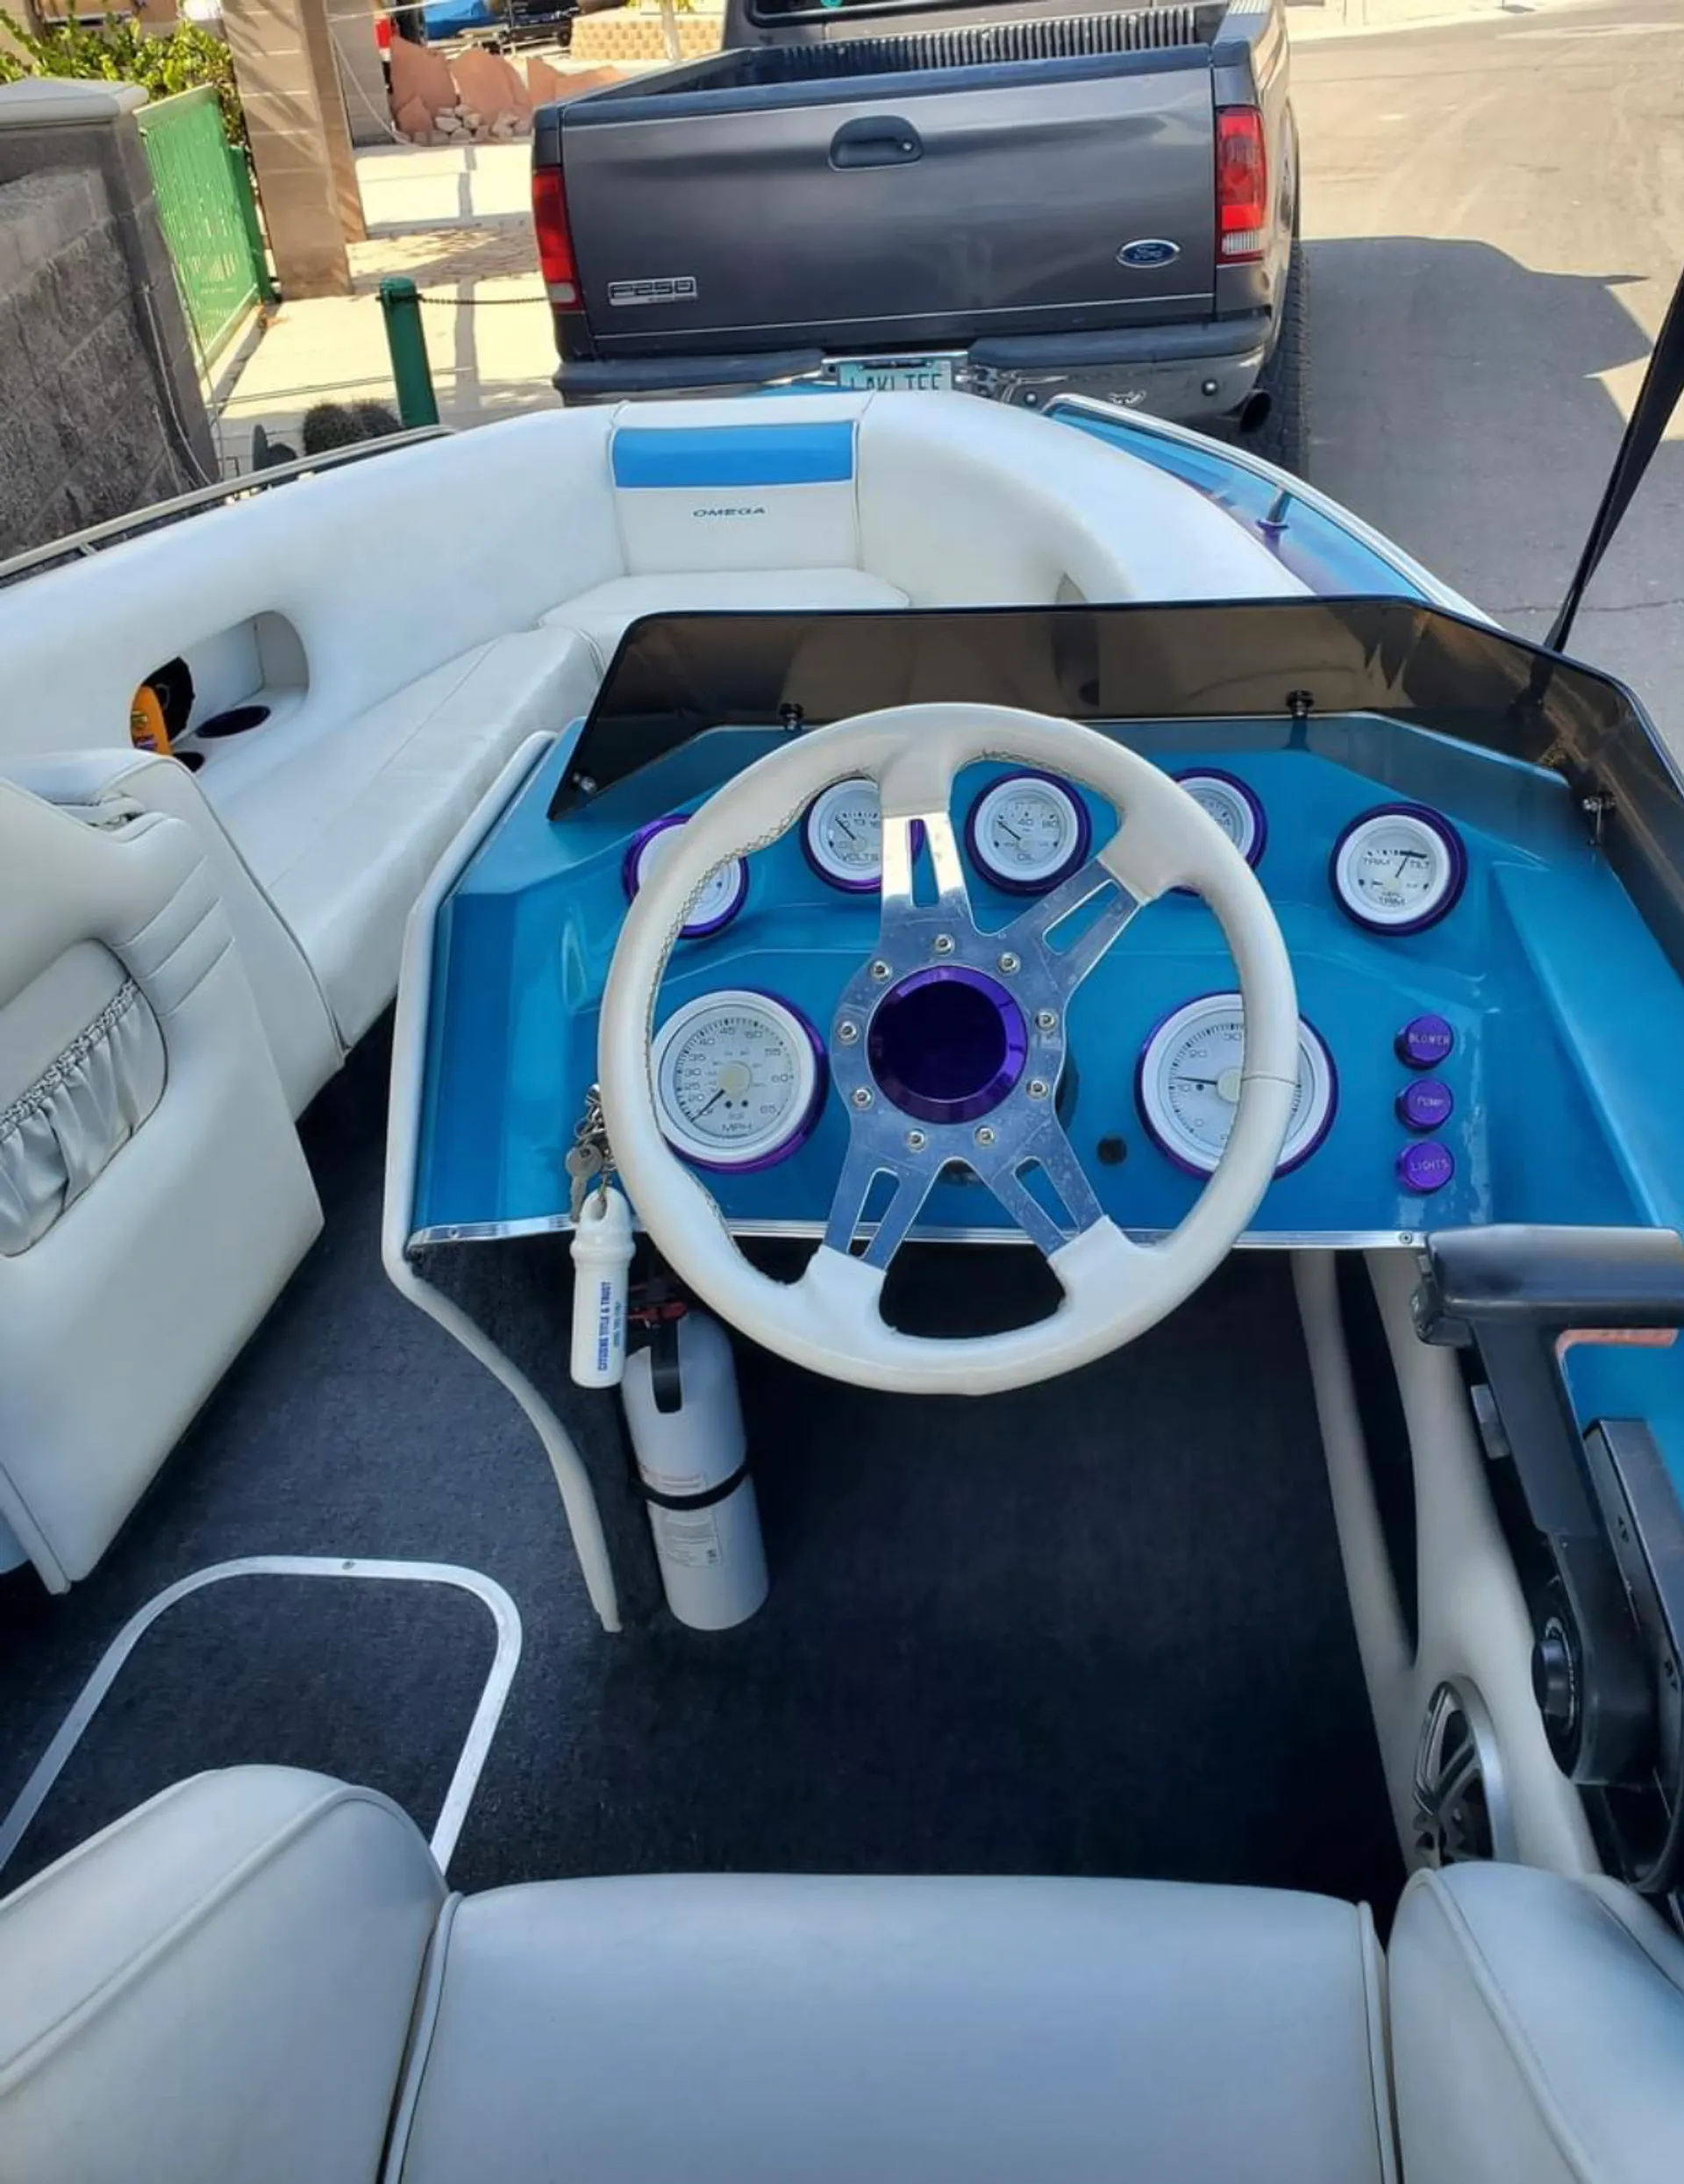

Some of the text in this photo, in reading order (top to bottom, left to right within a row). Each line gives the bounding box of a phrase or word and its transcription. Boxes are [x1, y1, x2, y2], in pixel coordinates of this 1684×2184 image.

[693, 507, 766, 517] OMEGA
[1408, 1032, 1450, 1046] BLOWER
[1416, 1095, 1445, 1107] PUMP
[1410, 1158, 1450, 1173] LIGHTS
